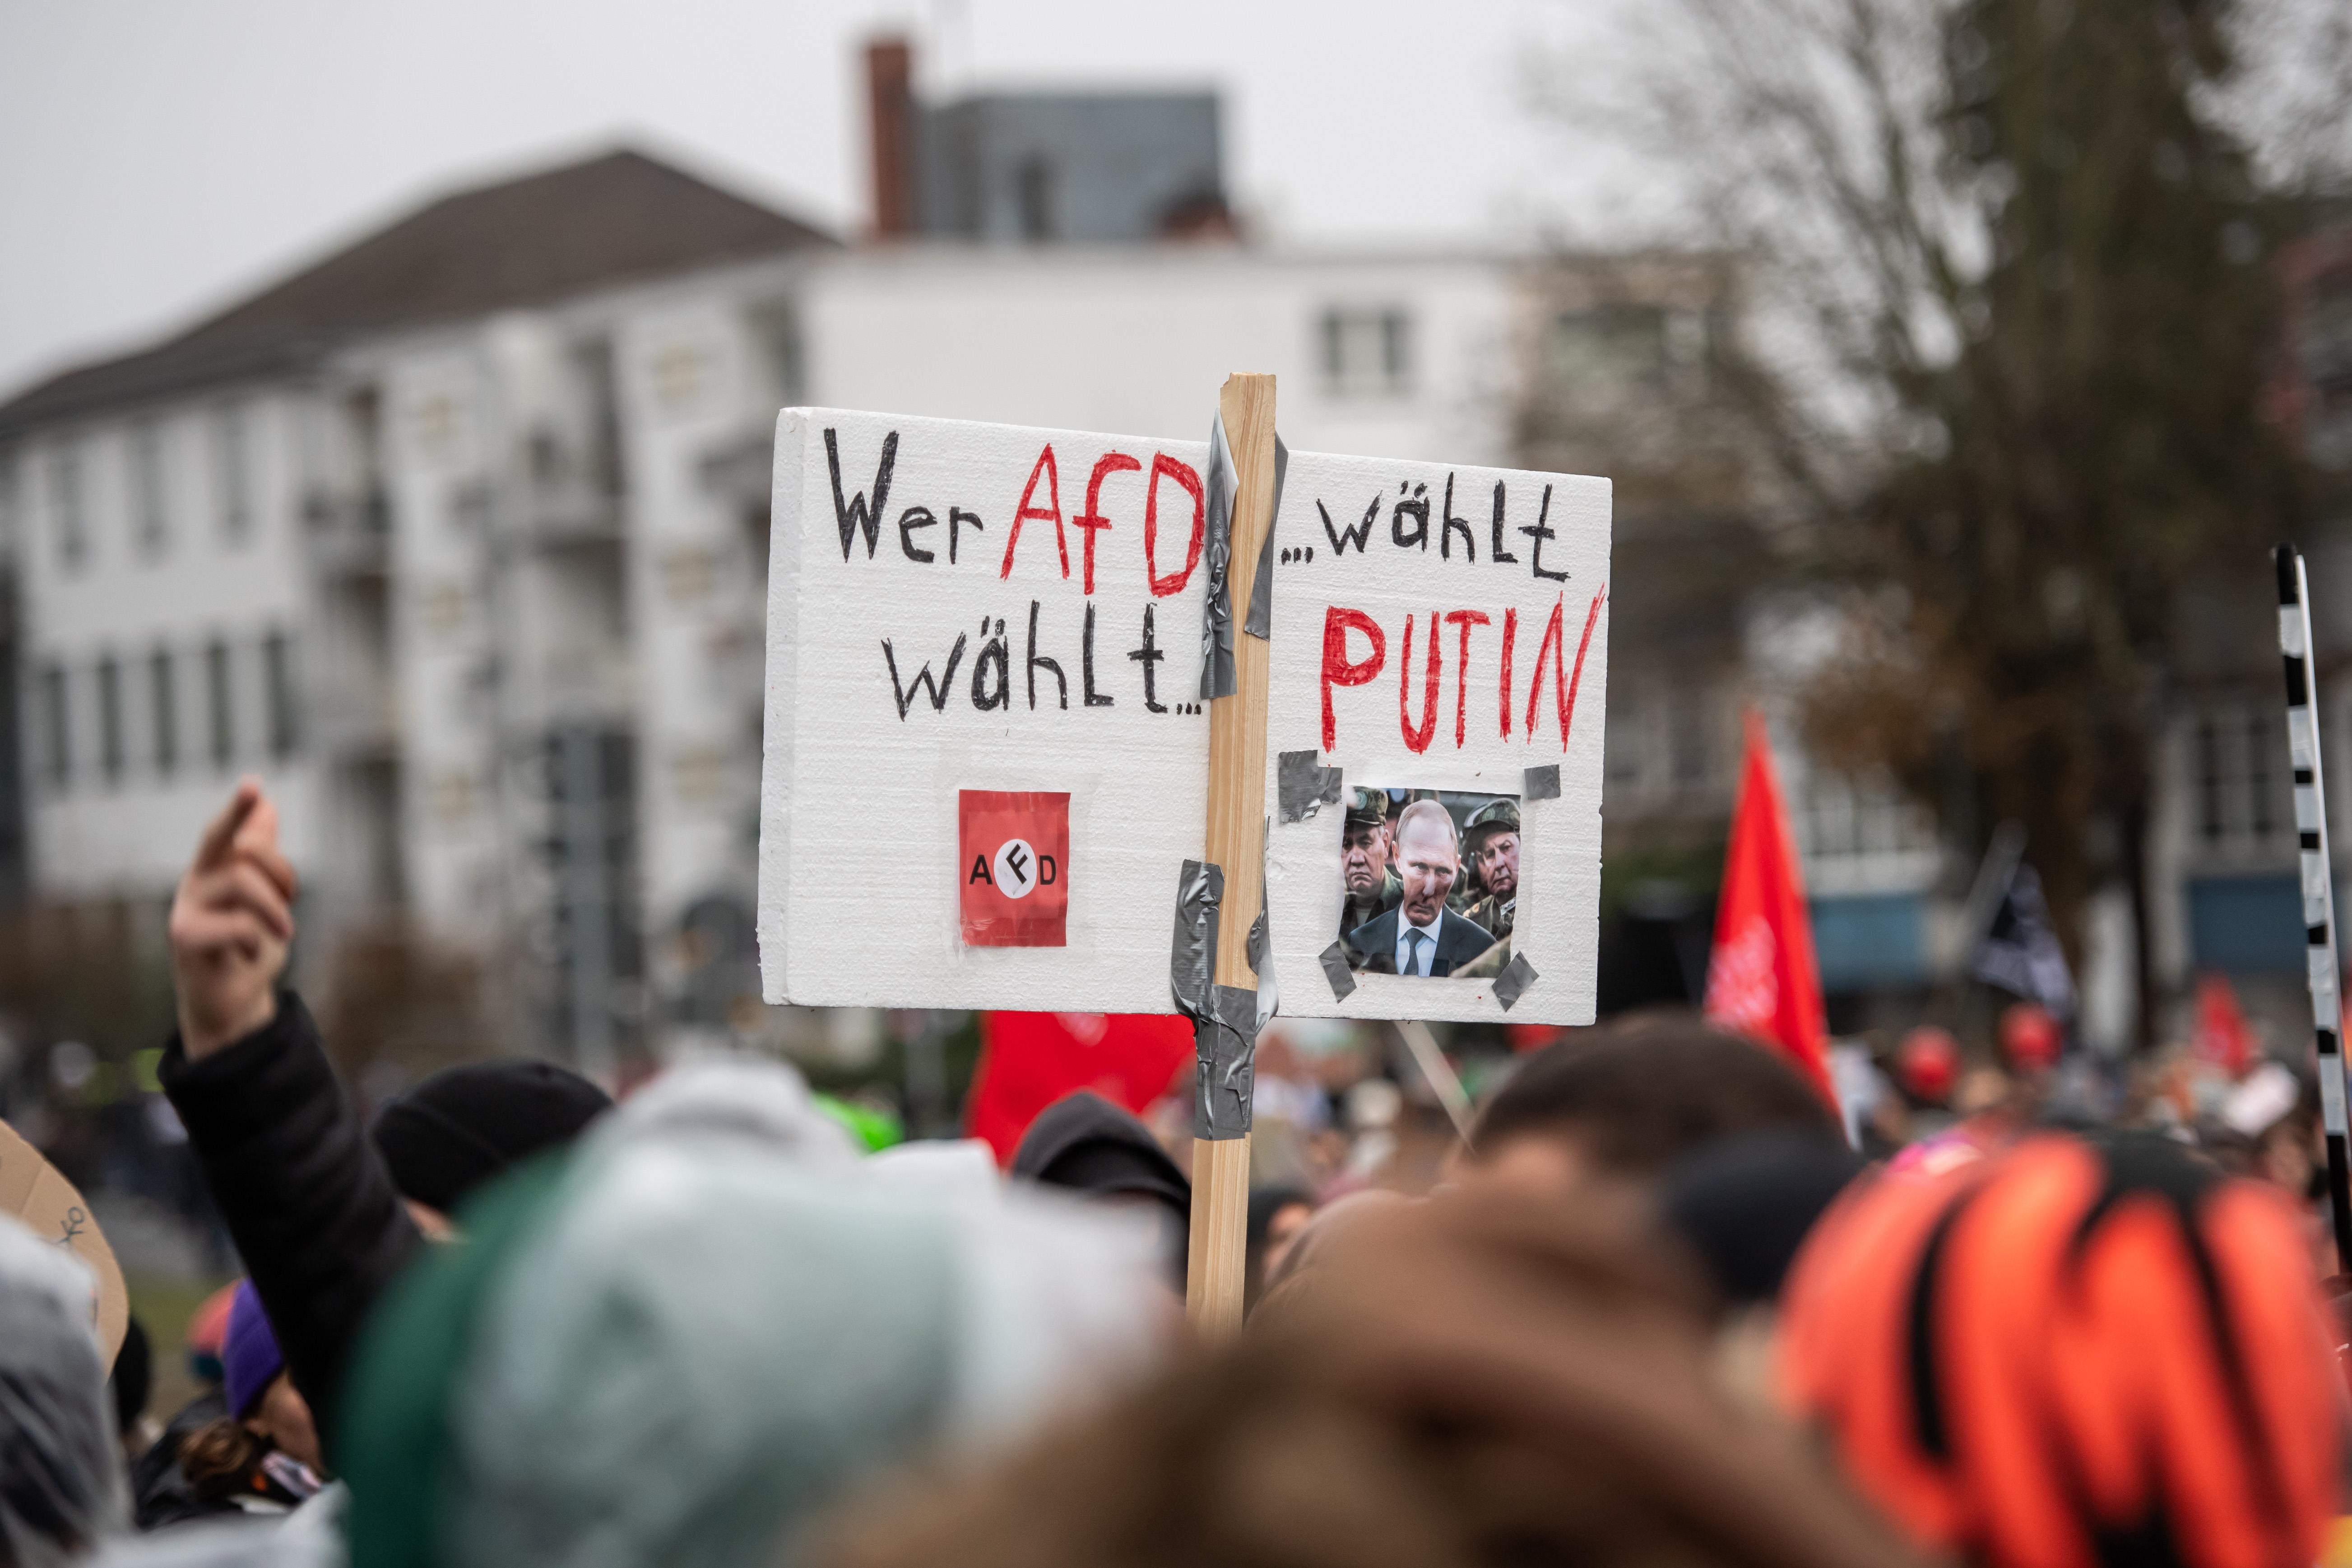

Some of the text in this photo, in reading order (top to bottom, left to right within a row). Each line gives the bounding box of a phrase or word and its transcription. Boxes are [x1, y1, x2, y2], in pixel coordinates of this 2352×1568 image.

[824, 428, 1205, 597] Wer AfD
[1321, 584, 1604, 753] PUTIN
